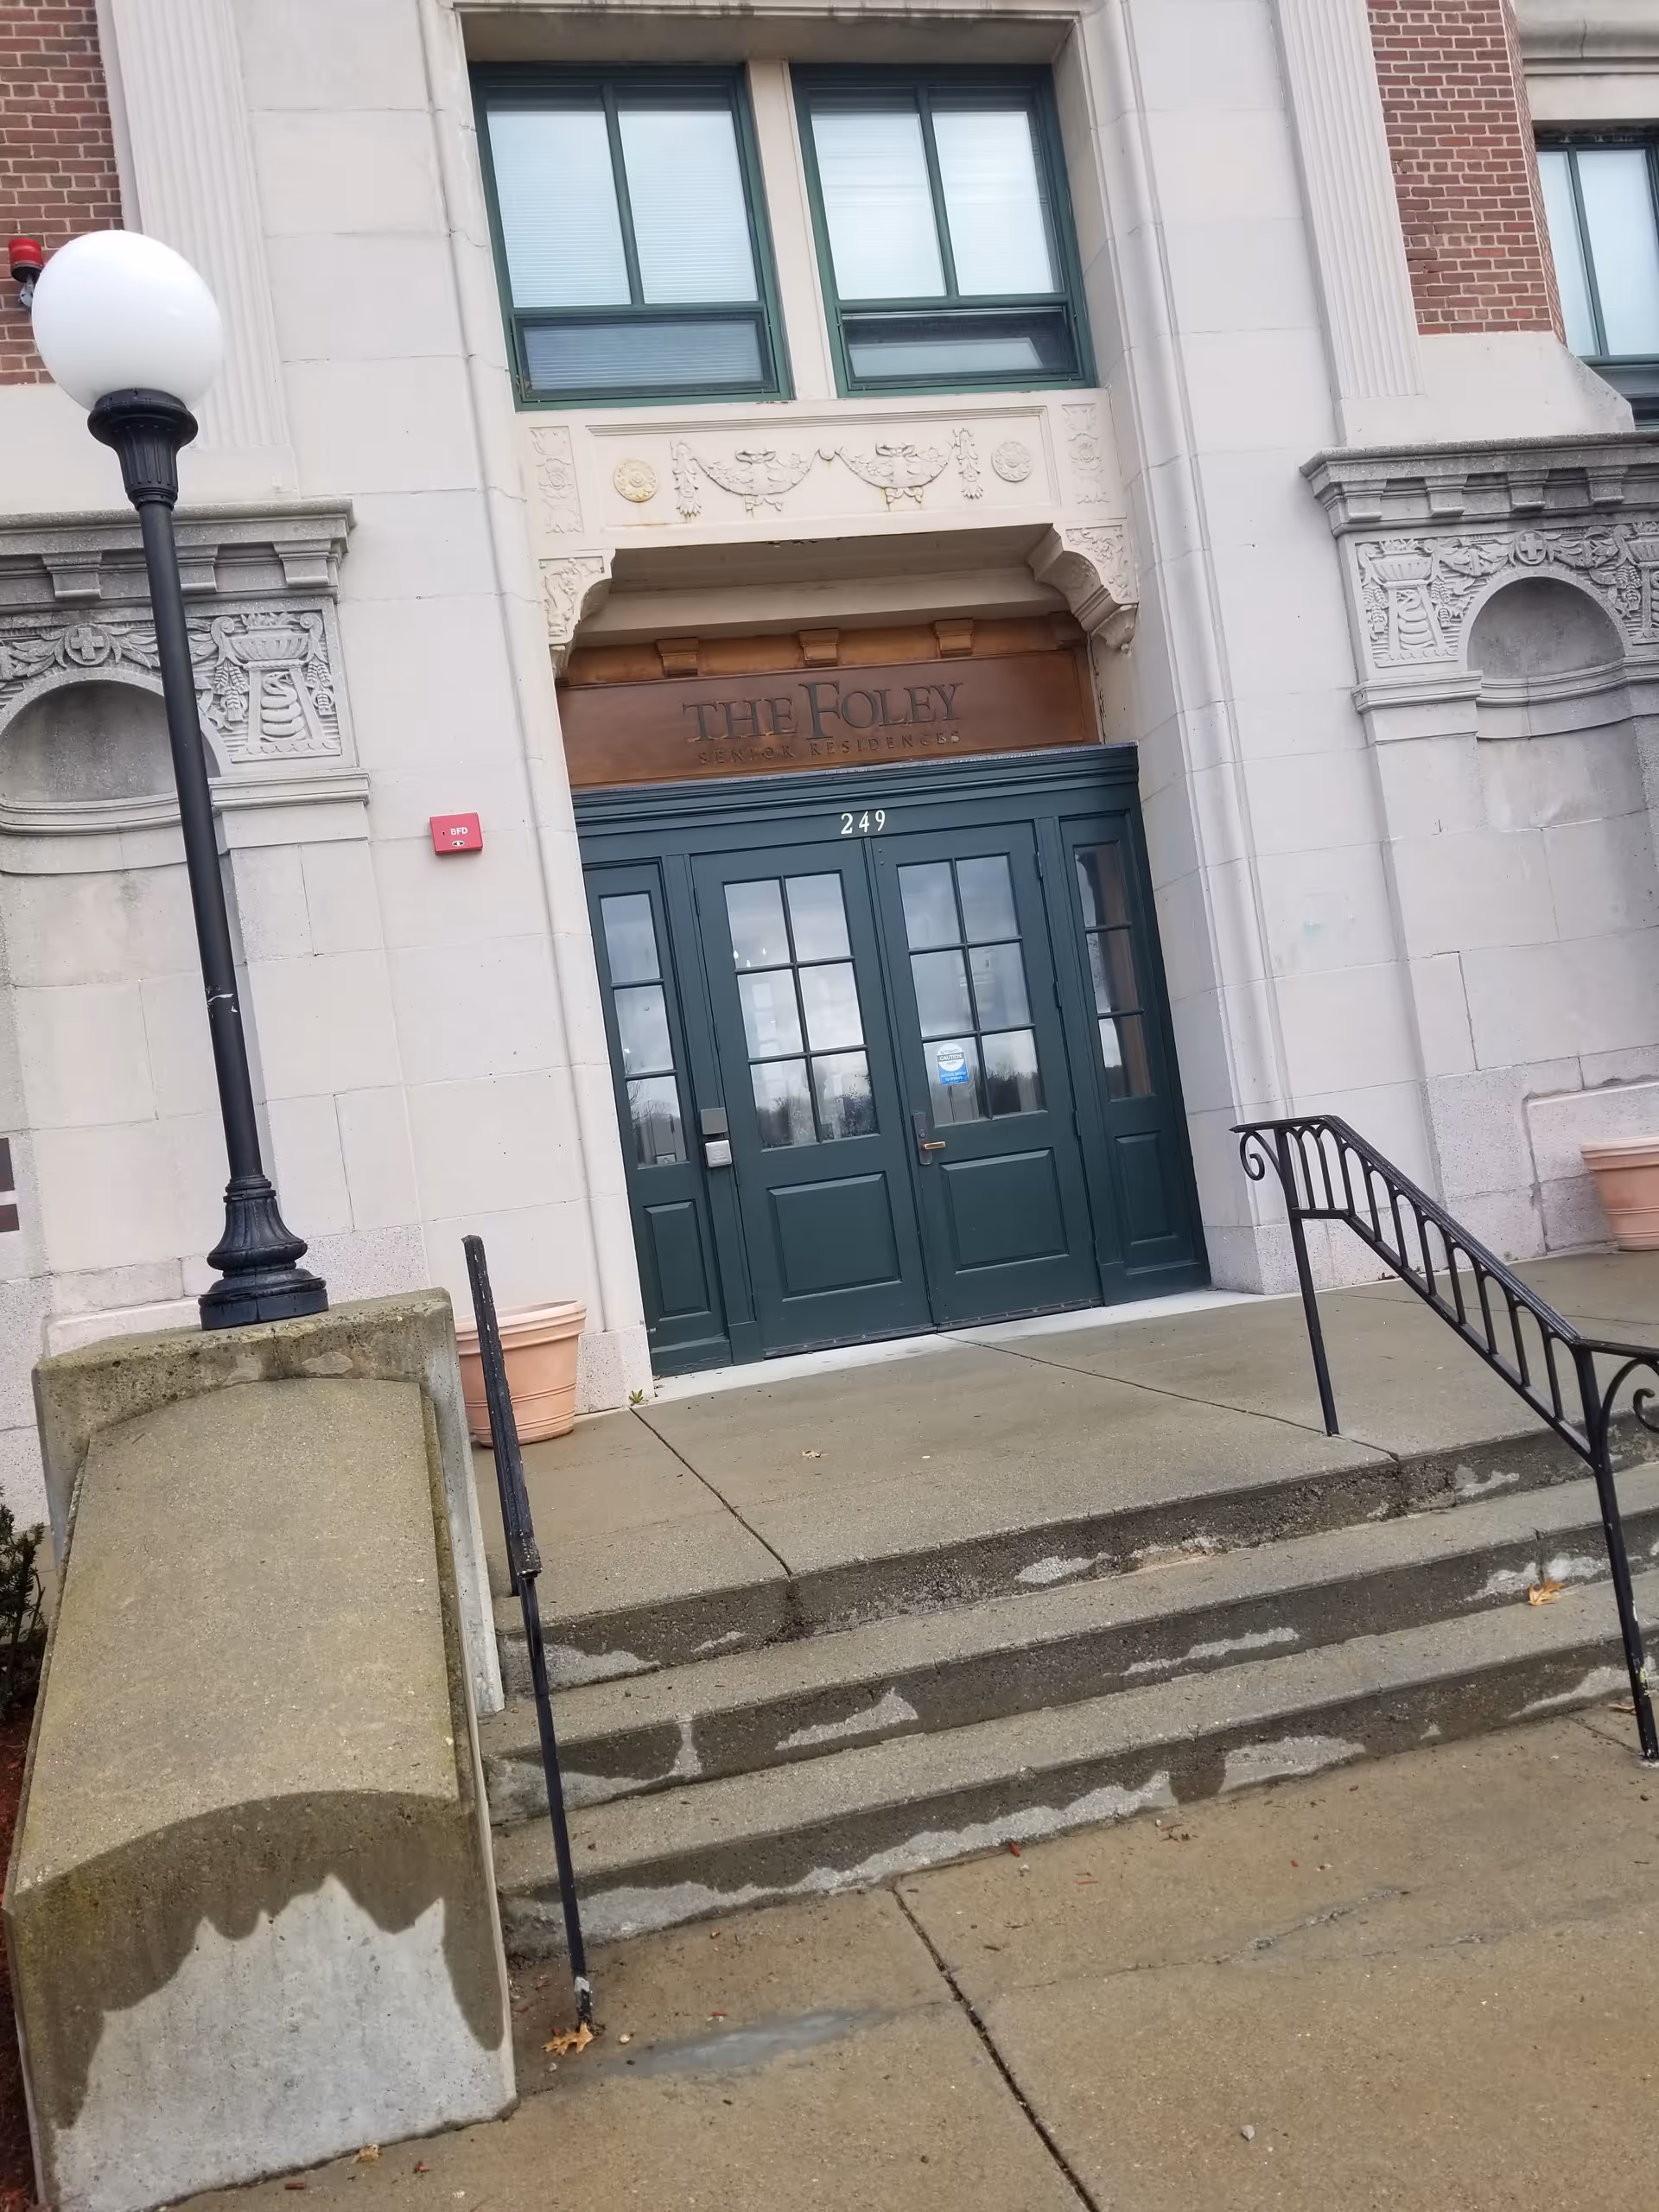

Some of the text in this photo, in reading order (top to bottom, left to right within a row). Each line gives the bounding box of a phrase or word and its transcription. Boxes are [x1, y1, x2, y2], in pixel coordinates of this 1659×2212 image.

[682, 681, 964, 741] THE FOLEY
[698, 731, 962, 766] SENIOR RESIDENCES
[450, 827, 468, 836] BFD
[840, 810, 886, 835] 249
